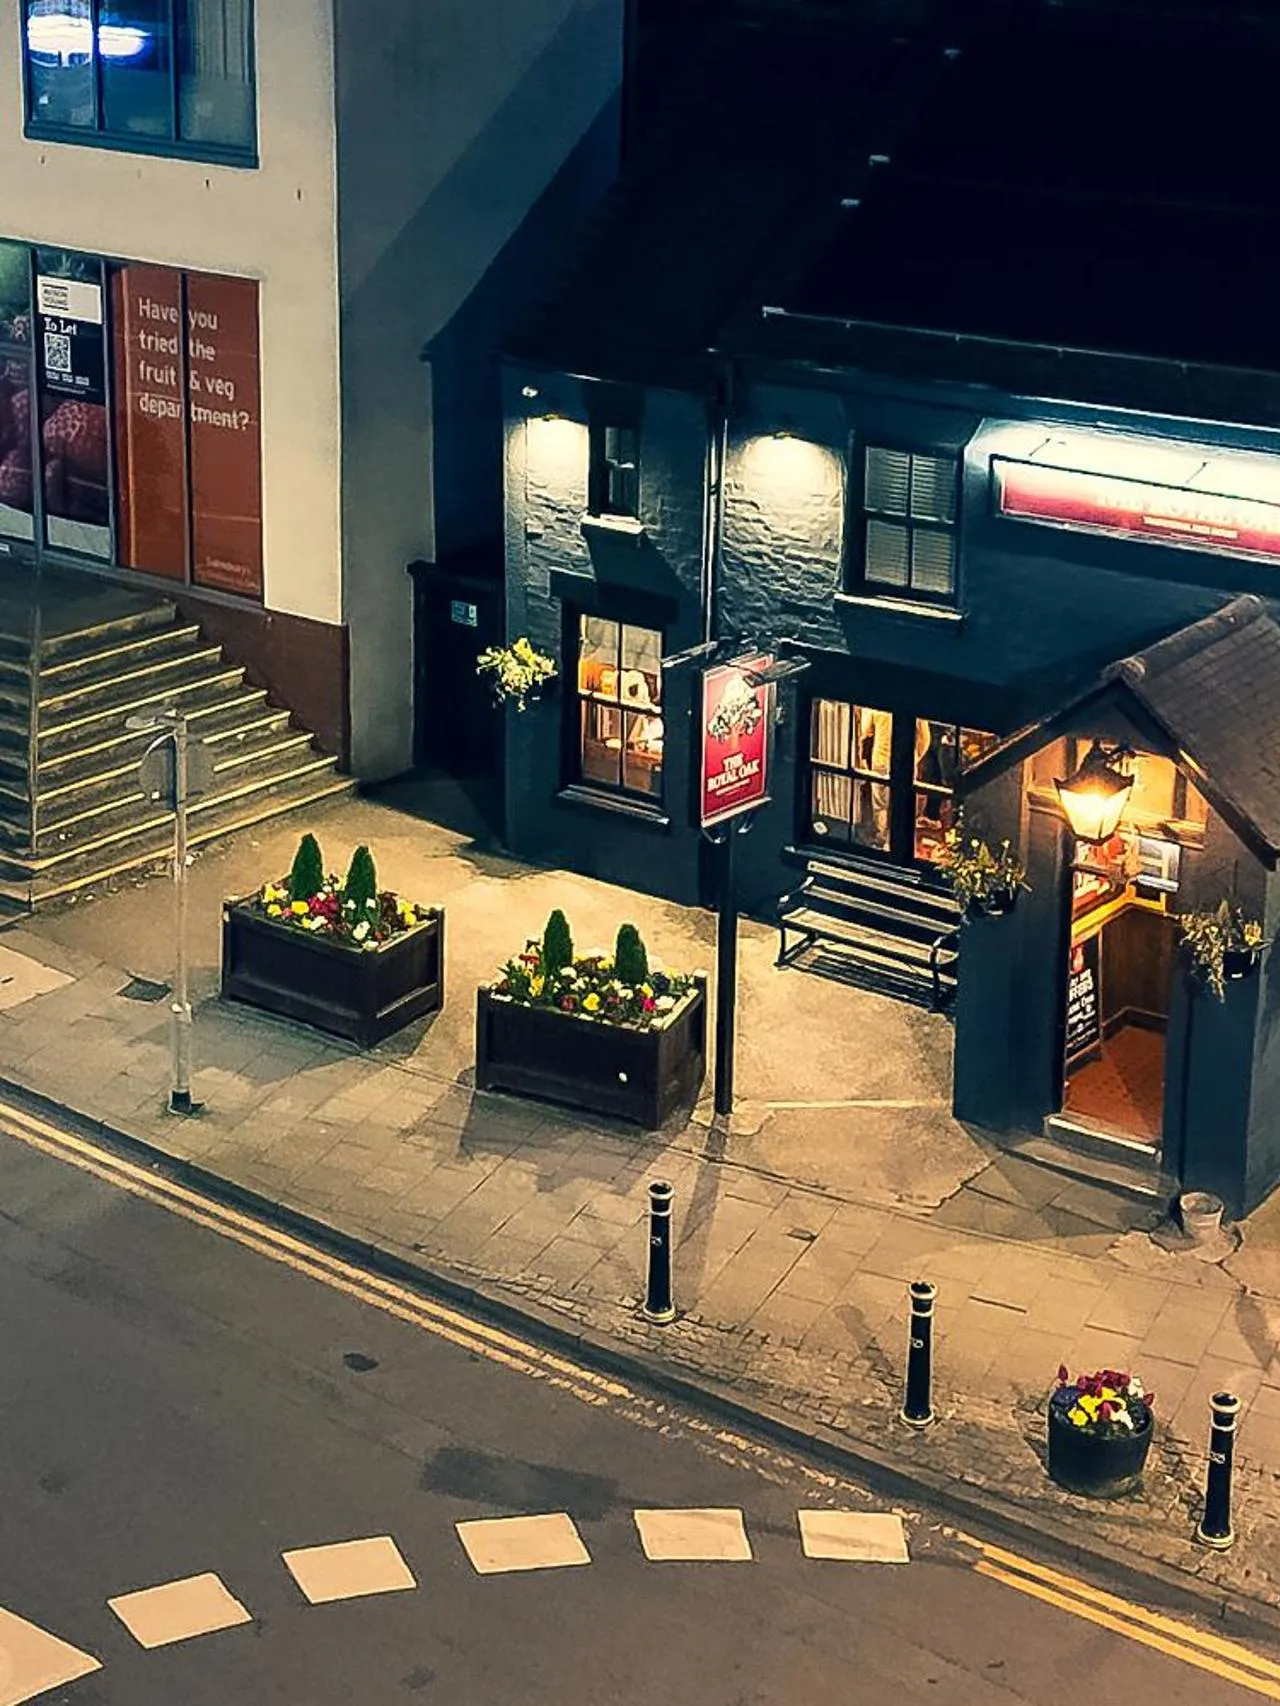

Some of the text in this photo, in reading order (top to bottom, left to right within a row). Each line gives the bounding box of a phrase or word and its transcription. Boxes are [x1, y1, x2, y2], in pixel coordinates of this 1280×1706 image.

[43, 316, 78, 336] To Let
[138, 296, 218, 331] Have you
[138, 328, 216, 362] tried the
[138, 359, 235, 402] fruit & veg
[708, 769, 739, 792] ROYAL
[739, 758, 760, 778] OAK
[723, 752, 743, 772] THE
